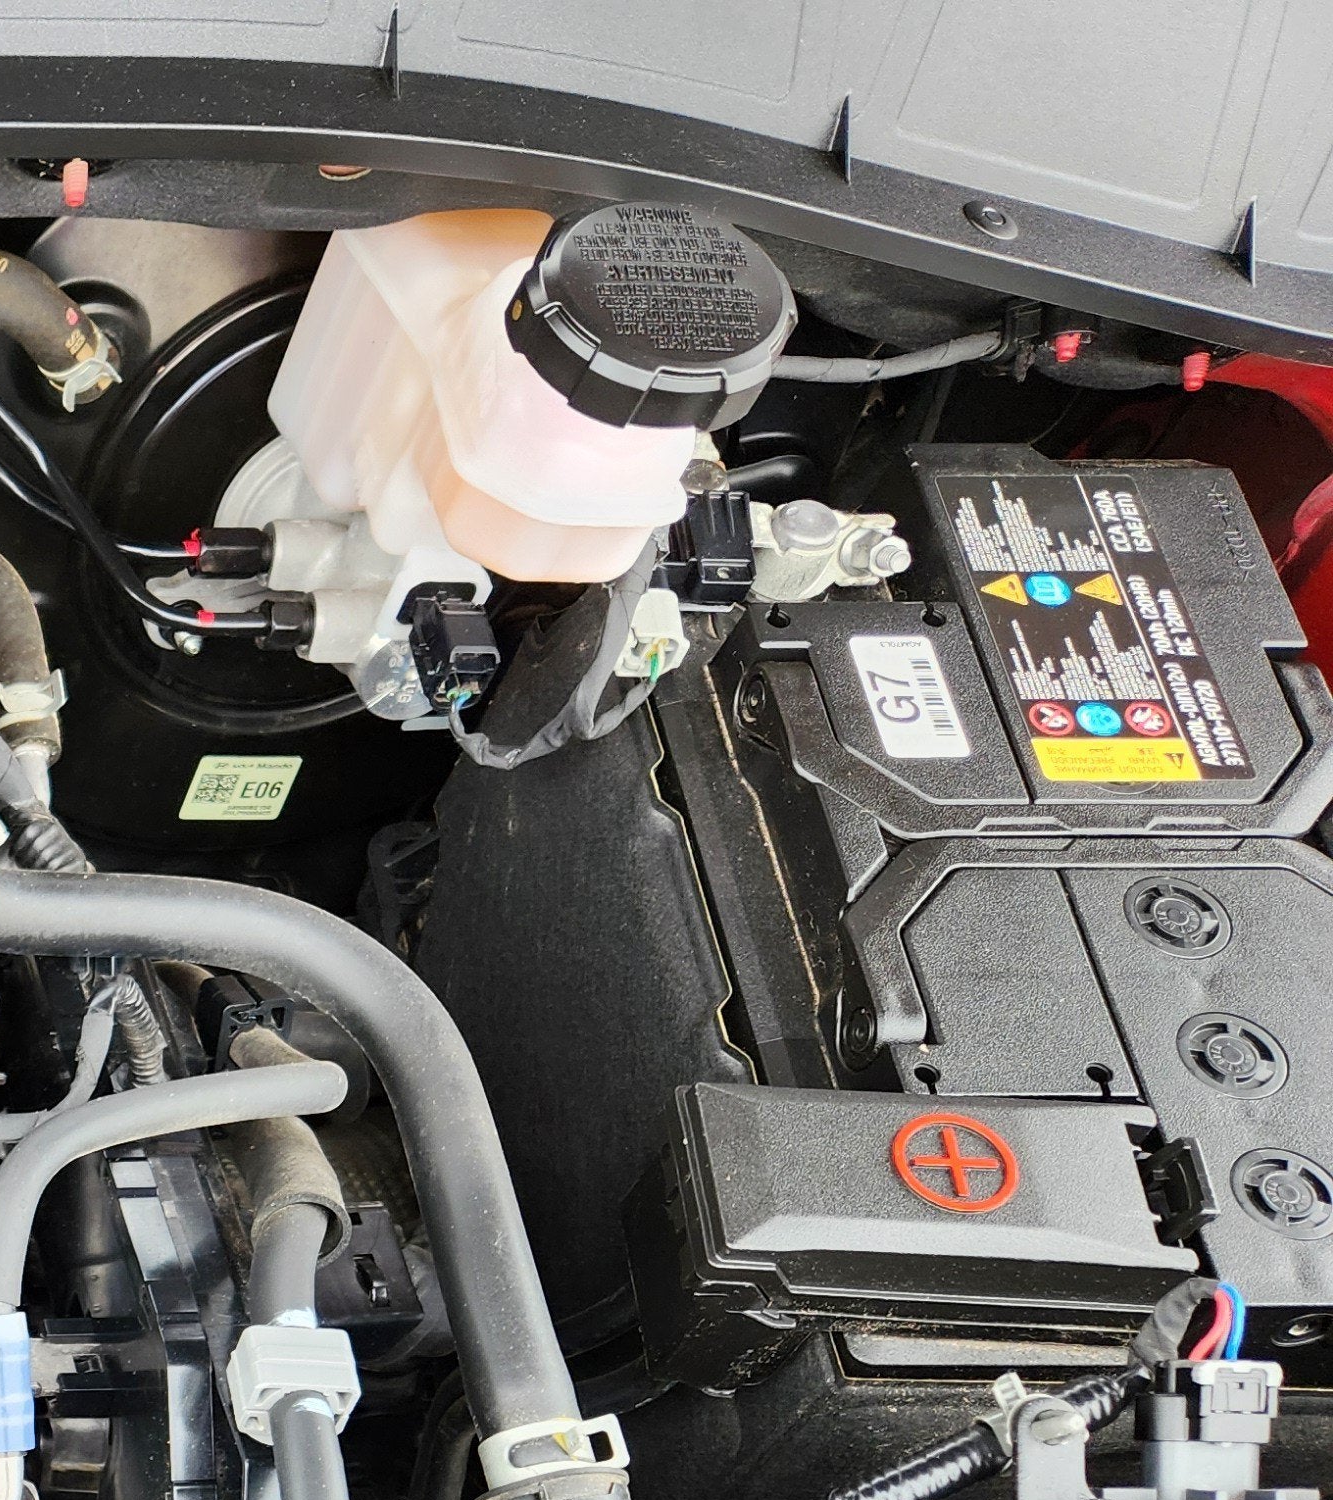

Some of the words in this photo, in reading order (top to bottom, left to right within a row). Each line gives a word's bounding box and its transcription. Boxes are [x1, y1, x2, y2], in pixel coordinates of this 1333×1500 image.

[615, 207, 694, 225] WARNING
[605, 264, 736, 285] AVERTISSEMENT
[1106, 524, 1134, 554] CCA
[866, 670, 921, 725] G7
[239, 780, 284, 799] E06
